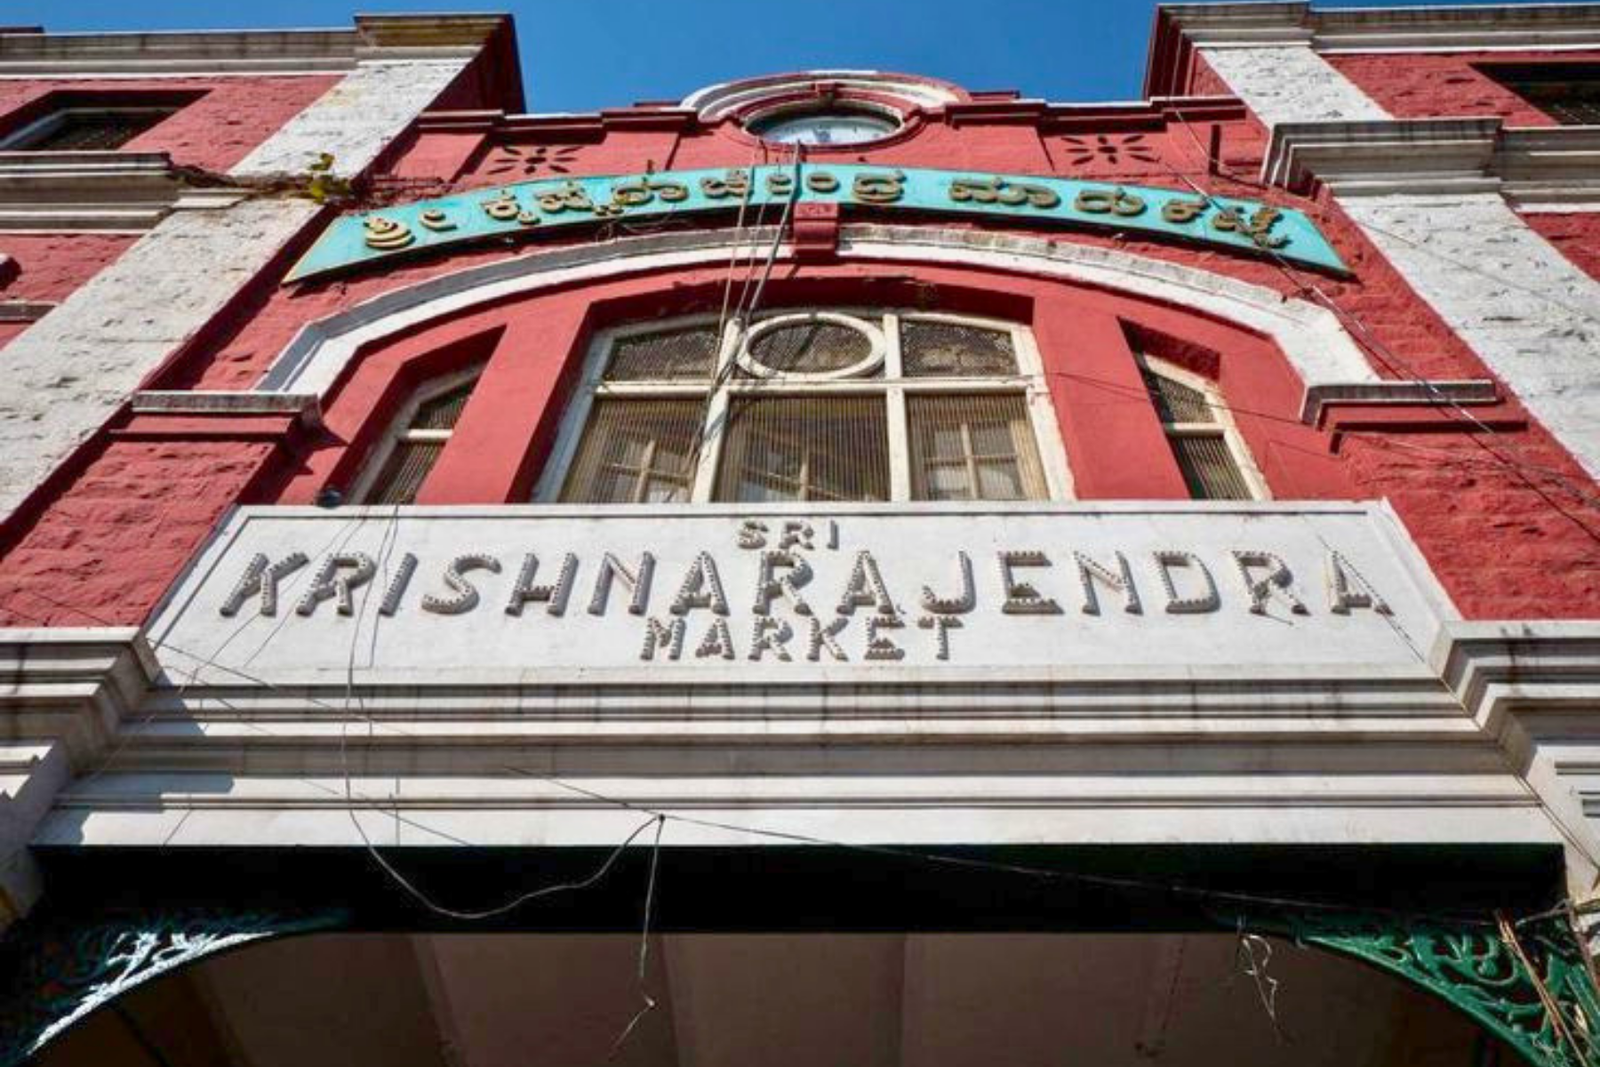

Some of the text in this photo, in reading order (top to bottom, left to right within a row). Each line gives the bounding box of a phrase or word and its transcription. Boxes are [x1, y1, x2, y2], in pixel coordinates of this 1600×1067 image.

[363, 215, 457, 248] ಶ್ರೀ
[738, 521, 839, 550] SRI
[220, 551, 1394, 616] KRISHNARAJENDRA
[640, 616, 964, 661] MARKET
